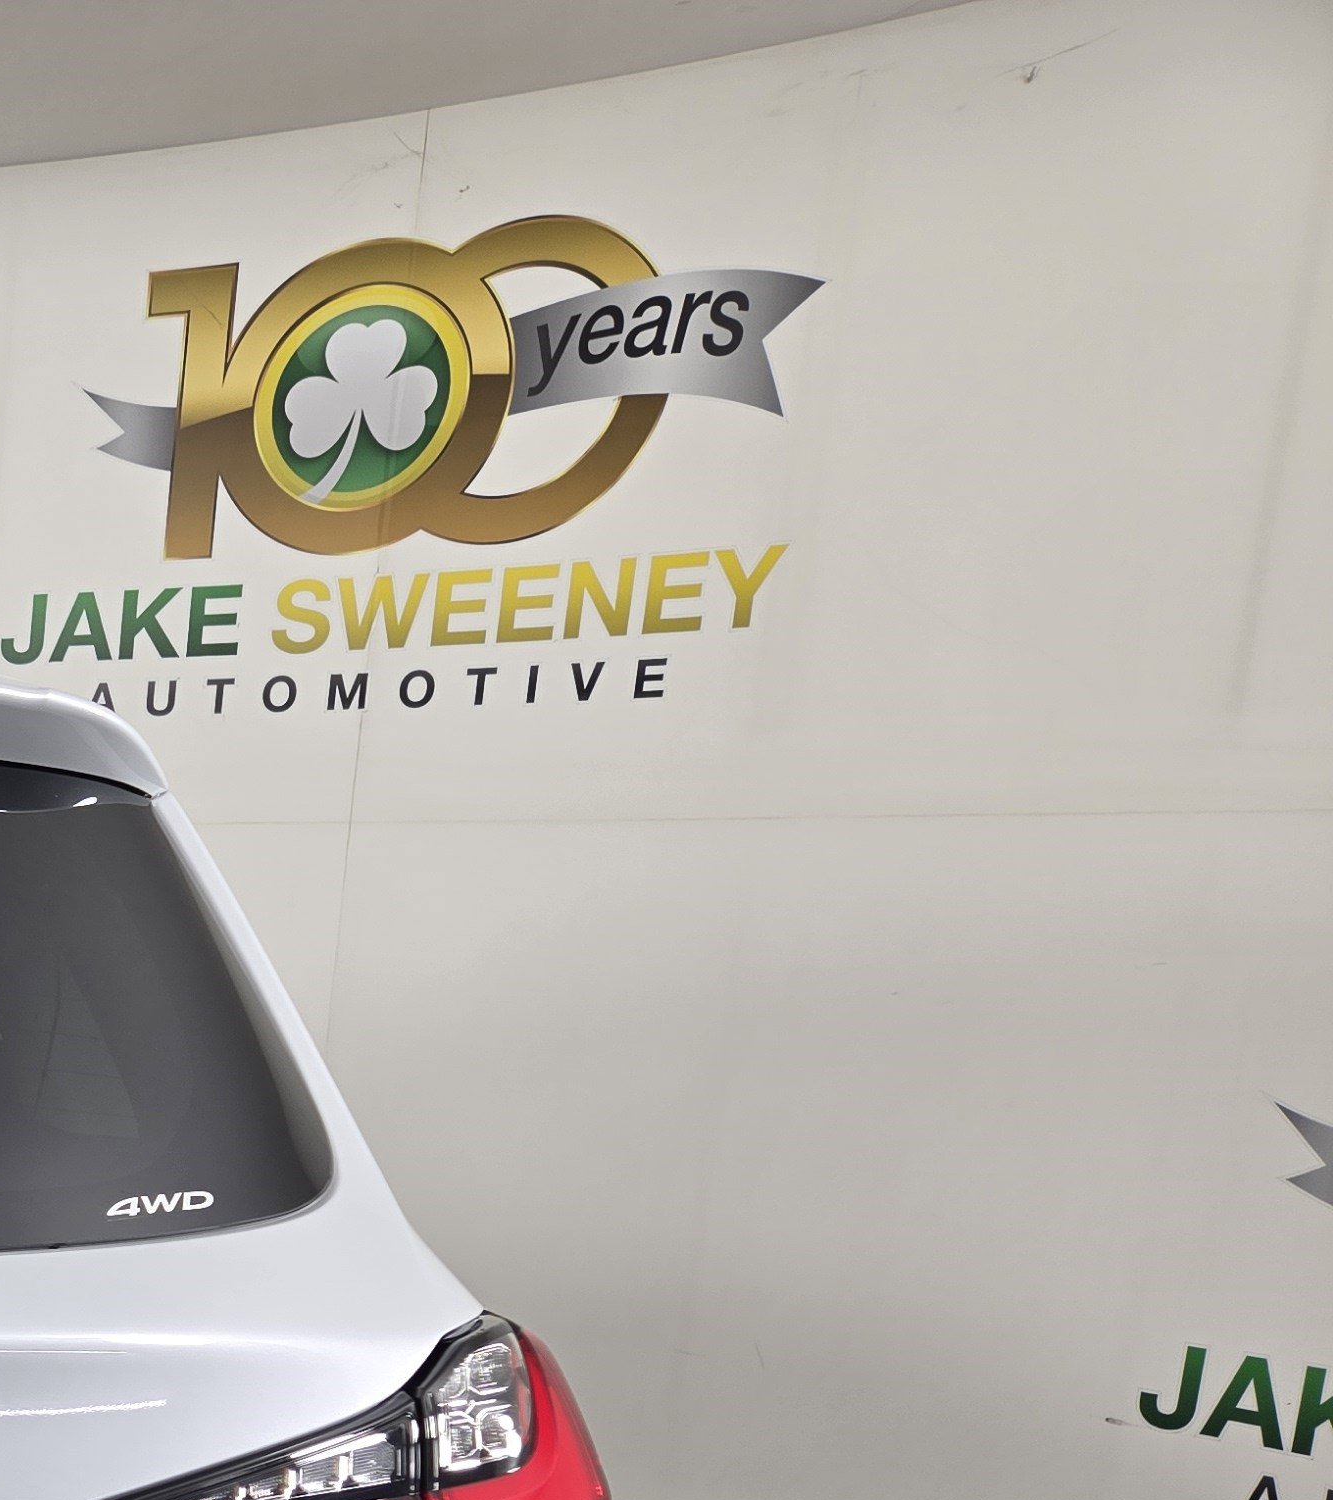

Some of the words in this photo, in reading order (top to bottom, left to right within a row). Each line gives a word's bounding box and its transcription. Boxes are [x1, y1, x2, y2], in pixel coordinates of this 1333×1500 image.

[527, 289, 750, 397] years
[0, 583, 244, 664] JAKE
[270, 543, 790, 655] SWEENEY
[91, 657, 670, 717] AUTOMOTIVE
[106, 1190, 215, 1217] 4WD
